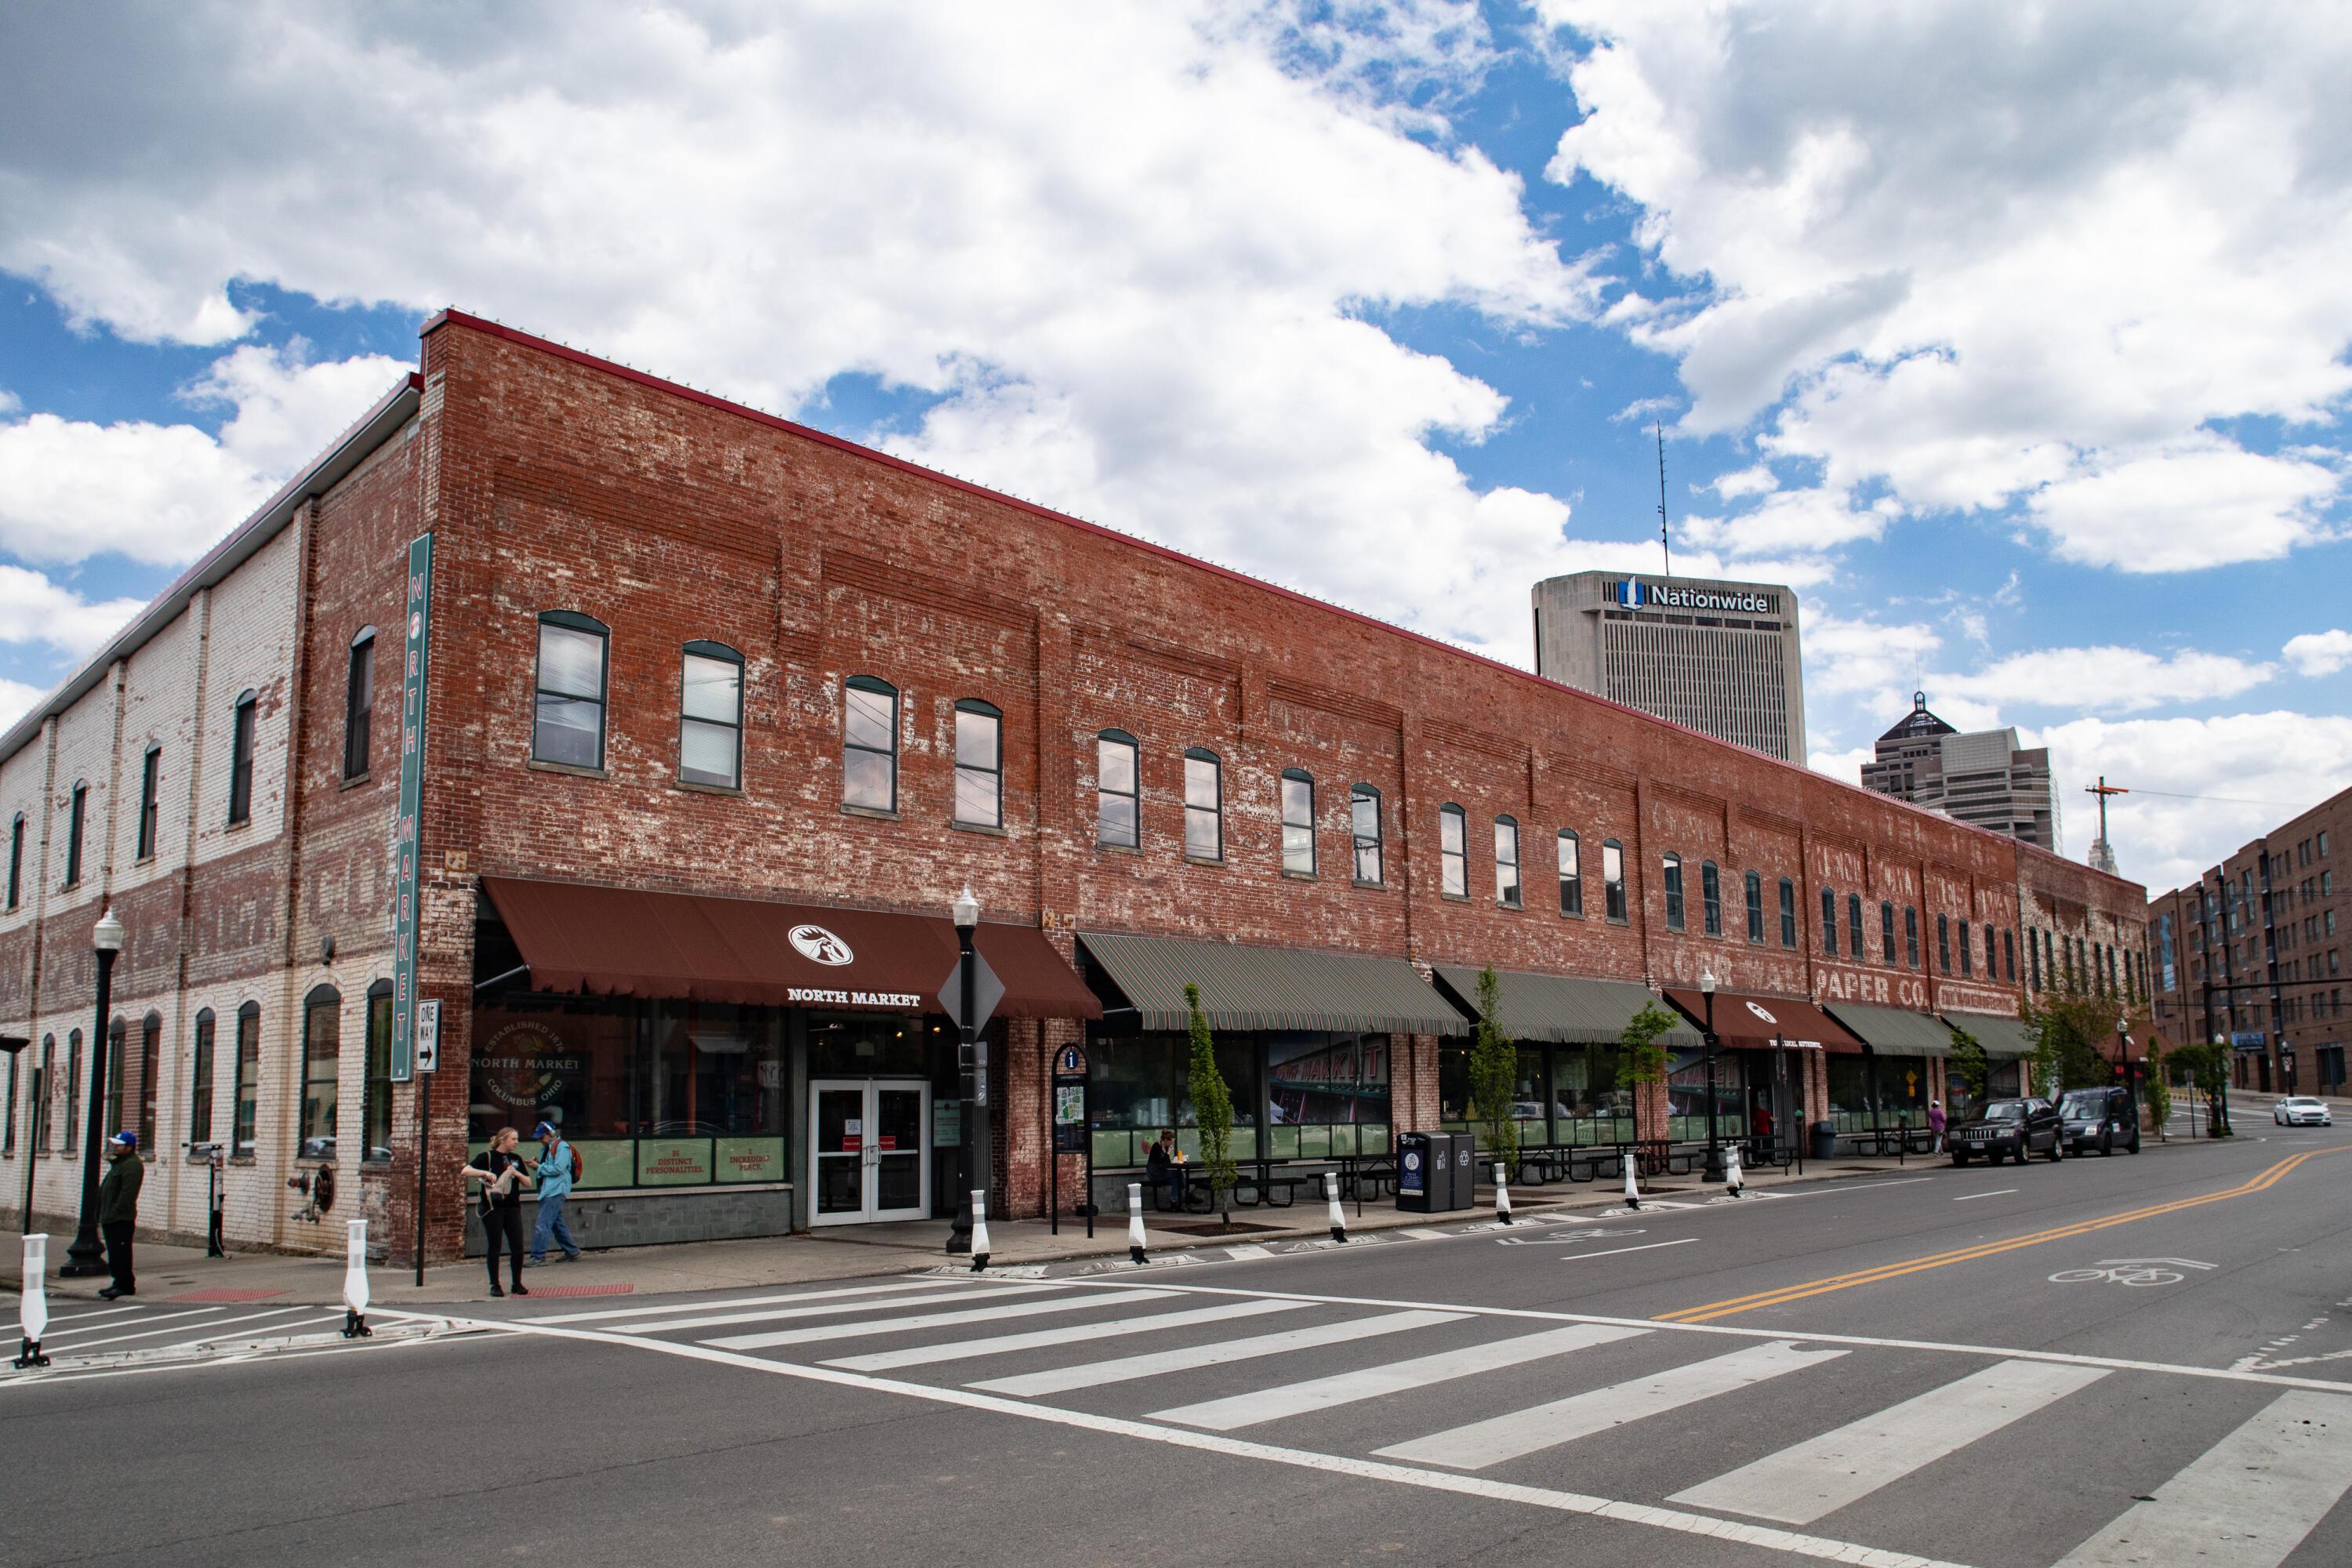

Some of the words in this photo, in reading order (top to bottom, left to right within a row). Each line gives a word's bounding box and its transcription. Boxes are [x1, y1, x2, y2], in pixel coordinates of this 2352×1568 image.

[1651, 586, 1768, 613] Nationwide
[397, 815, 413, 1041] MARKET
[1816, 968, 1889, 1004] PAPER
[1899, 979, 1929, 1007] CO.
[787, 988, 849, 1004] NORTH
[851, 992, 920, 1007] MARKET
[421, 1005, 434, 1022] ONE
[420, 1025, 434, 1041] WAY
[485, 1021, 549, 1052] ESTABLISHED
[470, 1058, 519, 1069] NORTH
[525, 1059, 579, 1069] MARKET
[488, 1079, 536, 1106] COLUMBUS
[541, 1080, 562, 1101] OHIO
[646, 1165, 703, 1174] PERSONALITIES.
[658, 1157, 693, 1166] DISTINCT
